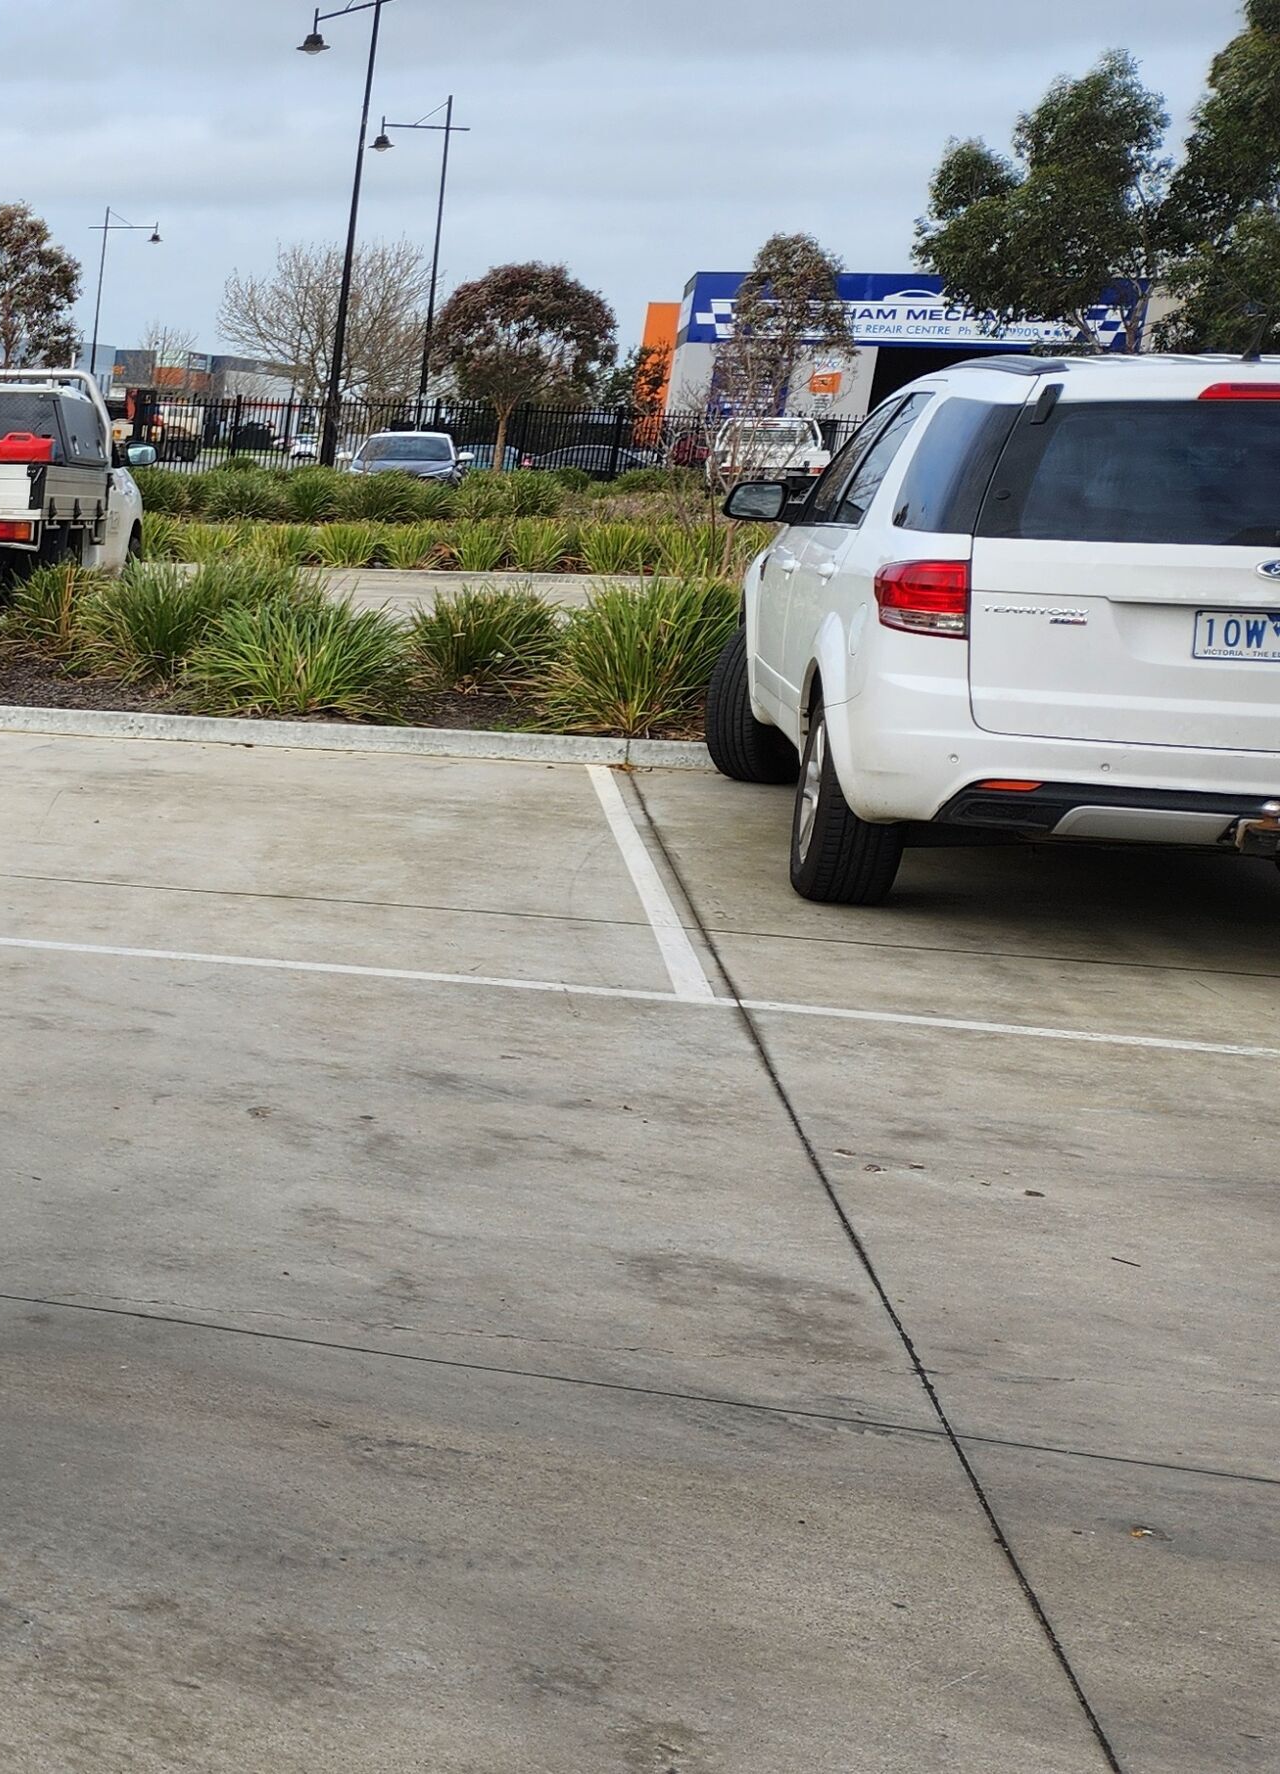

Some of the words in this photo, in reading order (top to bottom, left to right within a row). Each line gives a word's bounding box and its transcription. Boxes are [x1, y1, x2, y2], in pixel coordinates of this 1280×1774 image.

[865, 324, 902, 334] REPAIR
[906, 325, 951, 335] CENTRE
[981, 604, 1089, 617] TERRITORY
[1203, 648, 1244, 657] VICTORIA
[1253, 650, 1268, 658] THE
